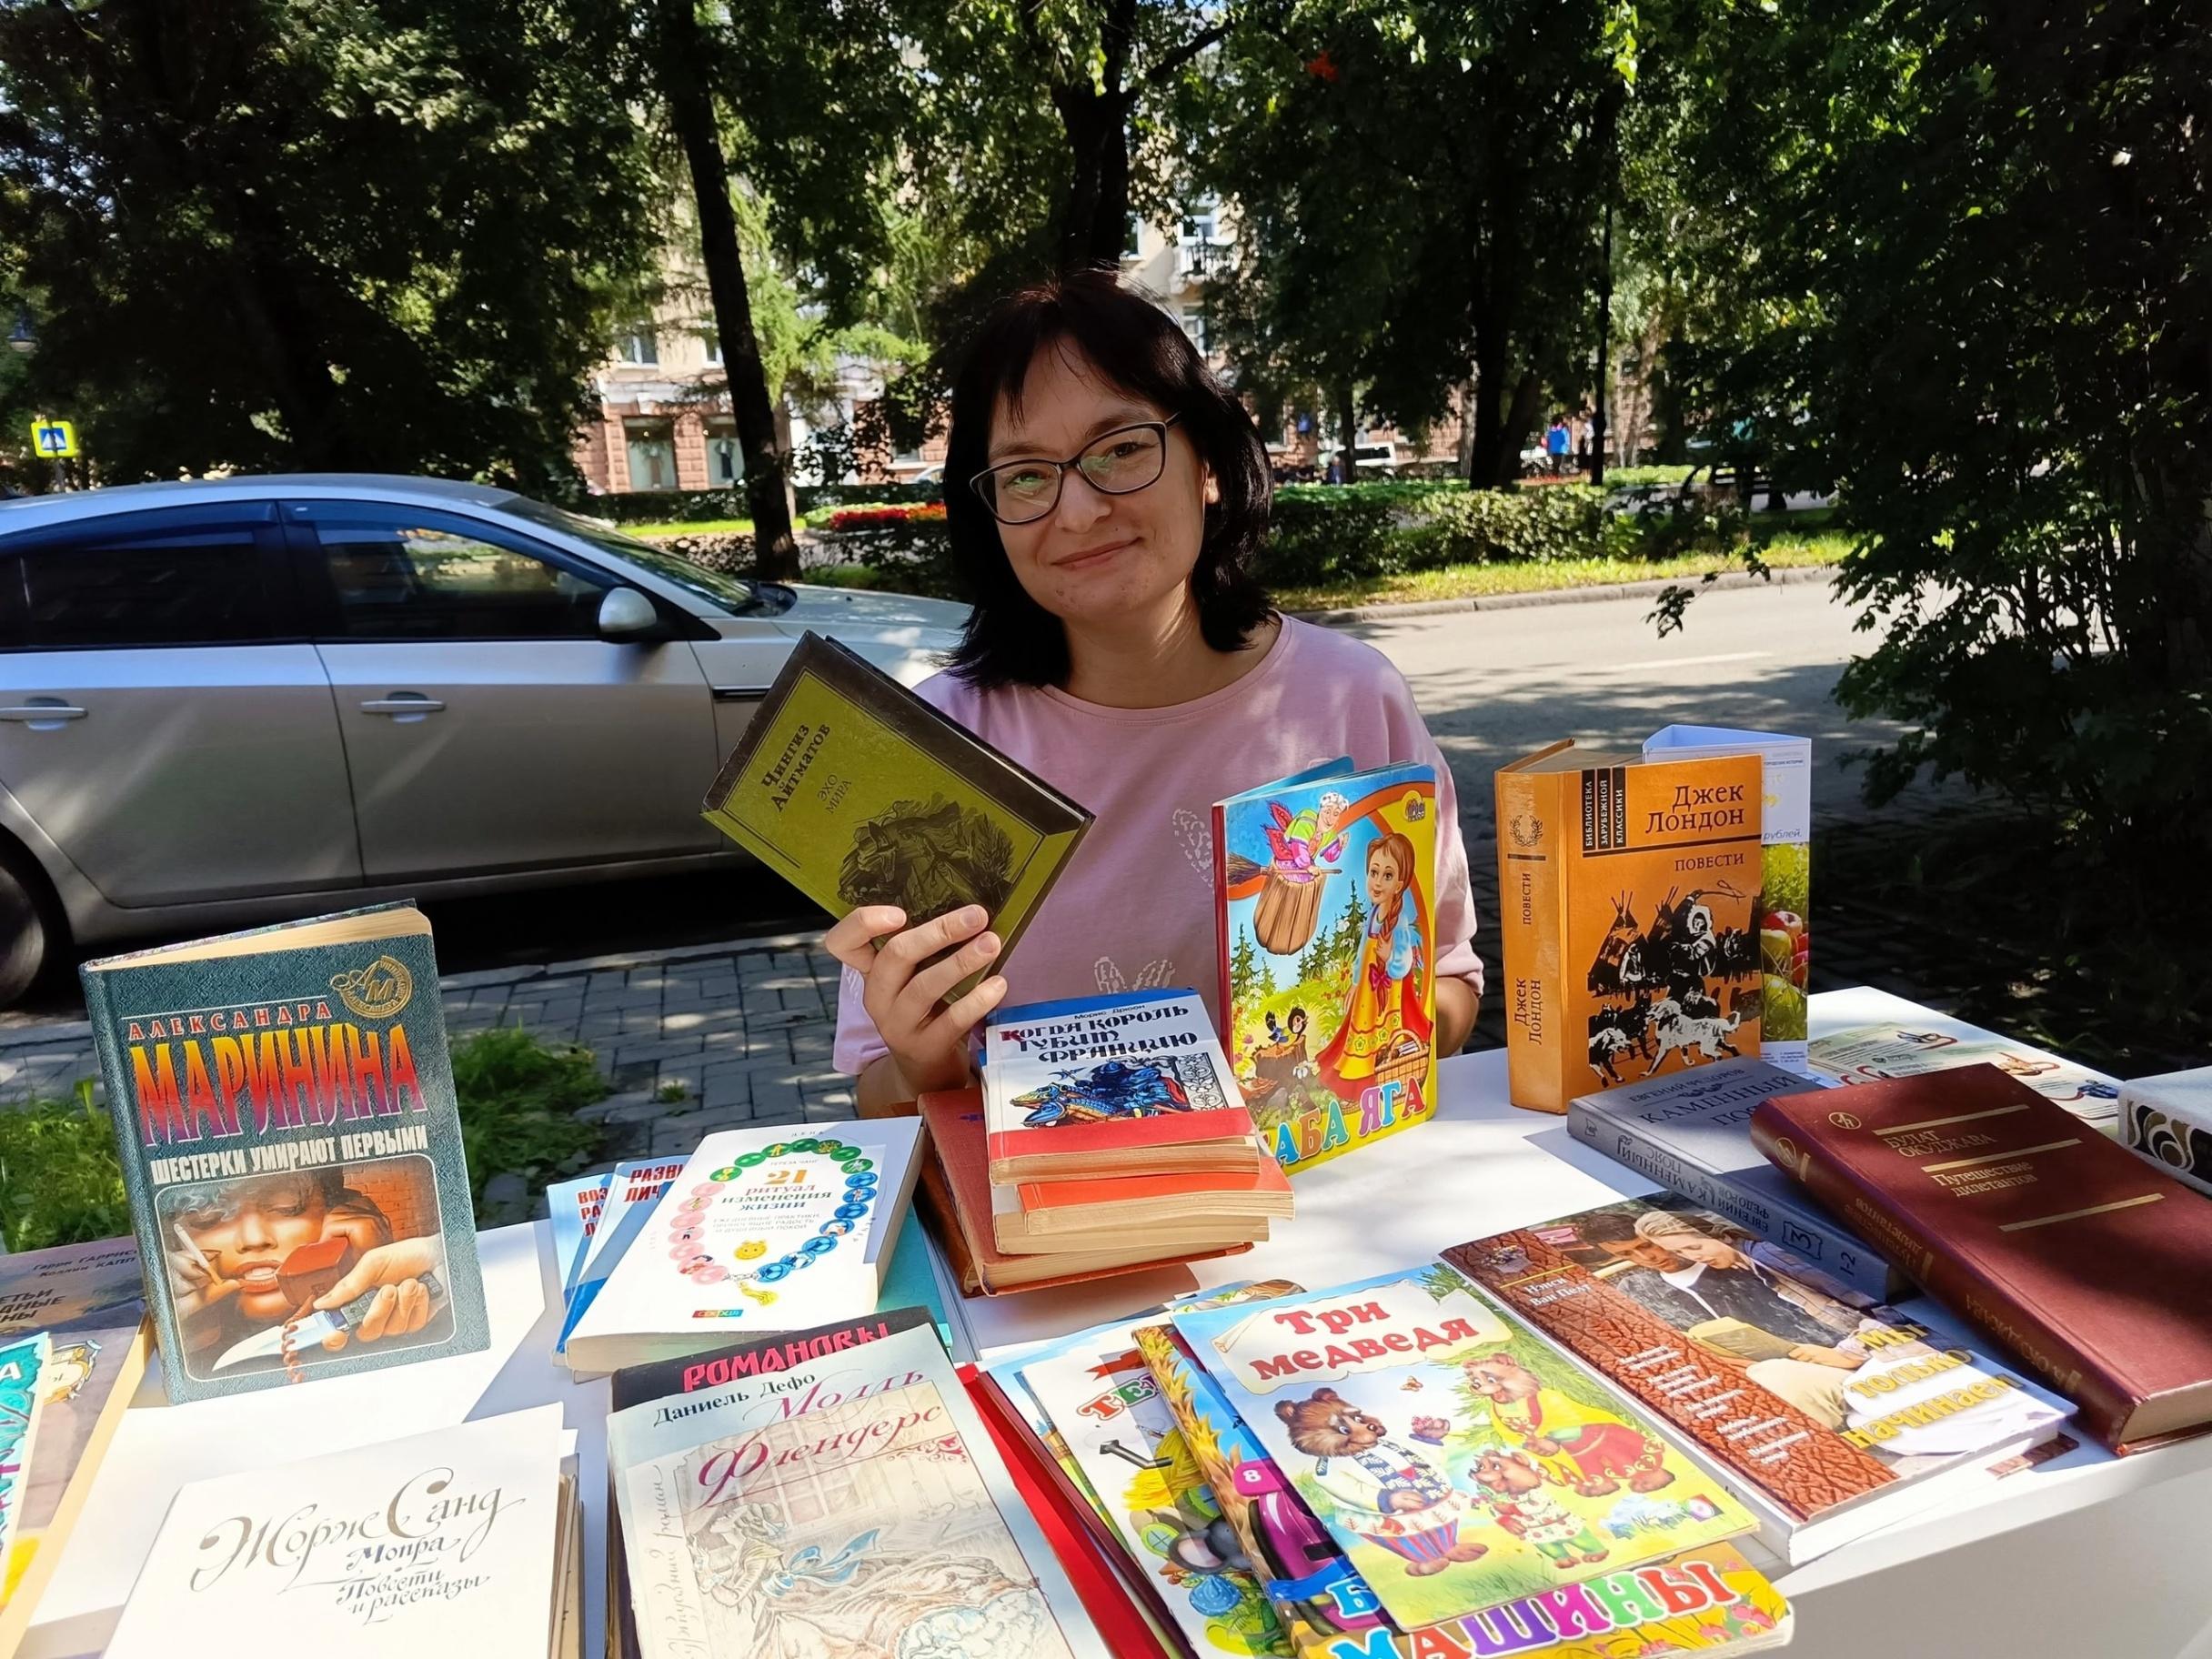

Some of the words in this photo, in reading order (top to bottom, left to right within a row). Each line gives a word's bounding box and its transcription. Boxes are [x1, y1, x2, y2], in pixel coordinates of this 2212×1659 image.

[760, 722, 809, 789] Чингиз
[770, 723, 831, 812] Айтматов
[818, 772, 838, 802] ЭХО
[825, 779, 852, 815] МИРА
[1672, 784, 1744, 813] Джек
[1584, 780, 1593, 847] БИБЛИОТЕКА
[1599, 779, 1608, 845] ЗАРУБЕЖНОЙ
[1614, 789, 1624, 844] КЛАССИКИ
[1645, 809, 1744, 834] Лондон
[1674, 852, 1744, 871] ПОВЕСТИ
[1523, 872, 1531, 926] ПОВЕСТИ
[1074, 1010, 1107, 1020] Морис
[1112, 1004, 1146, 1014] Дрюон
[1514, 978, 1530, 1026] Джек
[1528, 980, 1543, 1046] Лондон
[128, 1000, 333, 1041] АЛЕКСАНДРА
[130, 1023, 428, 1147] МАРИНИНА
[1629, 1081, 1685, 1102] ЕВГЕНИЙ
[1639, 1075, 1801, 1124] КАМЕННЫЙ
[1264, 1100, 1350, 1167] АБА
[1358, 1077, 1426, 1137] ЯГА
[1711, 1105, 1757, 1126] ПО
[151, 1151, 246, 1183] ШЕСТЕРКИ
[249, 1137, 337, 1177] УМИРАЮТ
[341, 1125, 428, 1161] ПЕРВЫМИ
[1883, 1130, 1939, 1149] БУЛАТ
[1898, 1134, 2000, 1158] ОКУДЖАВА
[763, 1170, 808, 1184] 21
[1623, 1144, 1707, 1201] КАМЕННЫЙ
[1646, 1146, 1682, 1174] ПОЯС
[1931, 1161, 2034, 1186] Путешествие
[578, 1187, 608, 1204] ВОЗ
[624, 1185, 661, 1202] ЛИЧ
[721, 1191, 832, 1203] изменения
[745, 1184, 816, 1196] ритуал
[1717, 1186, 1770, 1220] ФЕДОРОВ
[1951, 1173, 2038, 1197] дилетантов
[580, 1204, 604, 1220] РА
[739, 1202, 806, 1212] жизни
[1717, 1197, 1769, 1233] ЕВГЕНИЙ
[33, 1260, 74, 1271] Гарри
[78, 1250, 136, 1263] ГАРРИС
[0, 1288, 55, 1303] ЕТЬИ
[0, 1295, 66, 1313] ДНЫЕ
[1529, 1293, 1558, 1306] Ван
[0, 1310, 38, 1322] НЫ
[1274, 1299, 1391, 1337] Три
[0, 1362, 23, 1381] А
[683, 1322, 890, 1392] РОМАНОВЫ
[1849, 1348, 1973, 1398] только
[653, 1389, 750, 1428] Даниель
[759, 1372, 817, 1398] Дефо
[1077, 1372, 1157, 1421] ТЕ
[1838, 1374, 2024, 1449] начинаем
[697, 1403, 942, 1506] Флендерс
[1242, 1469, 1262, 1483] 8
[190, 1503, 382, 1594] Жорж
[386, 1466, 527, 1563] Санд
[346, 1534, 460, 1574] Мопра
[336, 1566, 443, 1606] Повести
[363, 1574, 492, 1626] рассказы
[1328, 1560, 1742, 1659] МАШИНЫ
